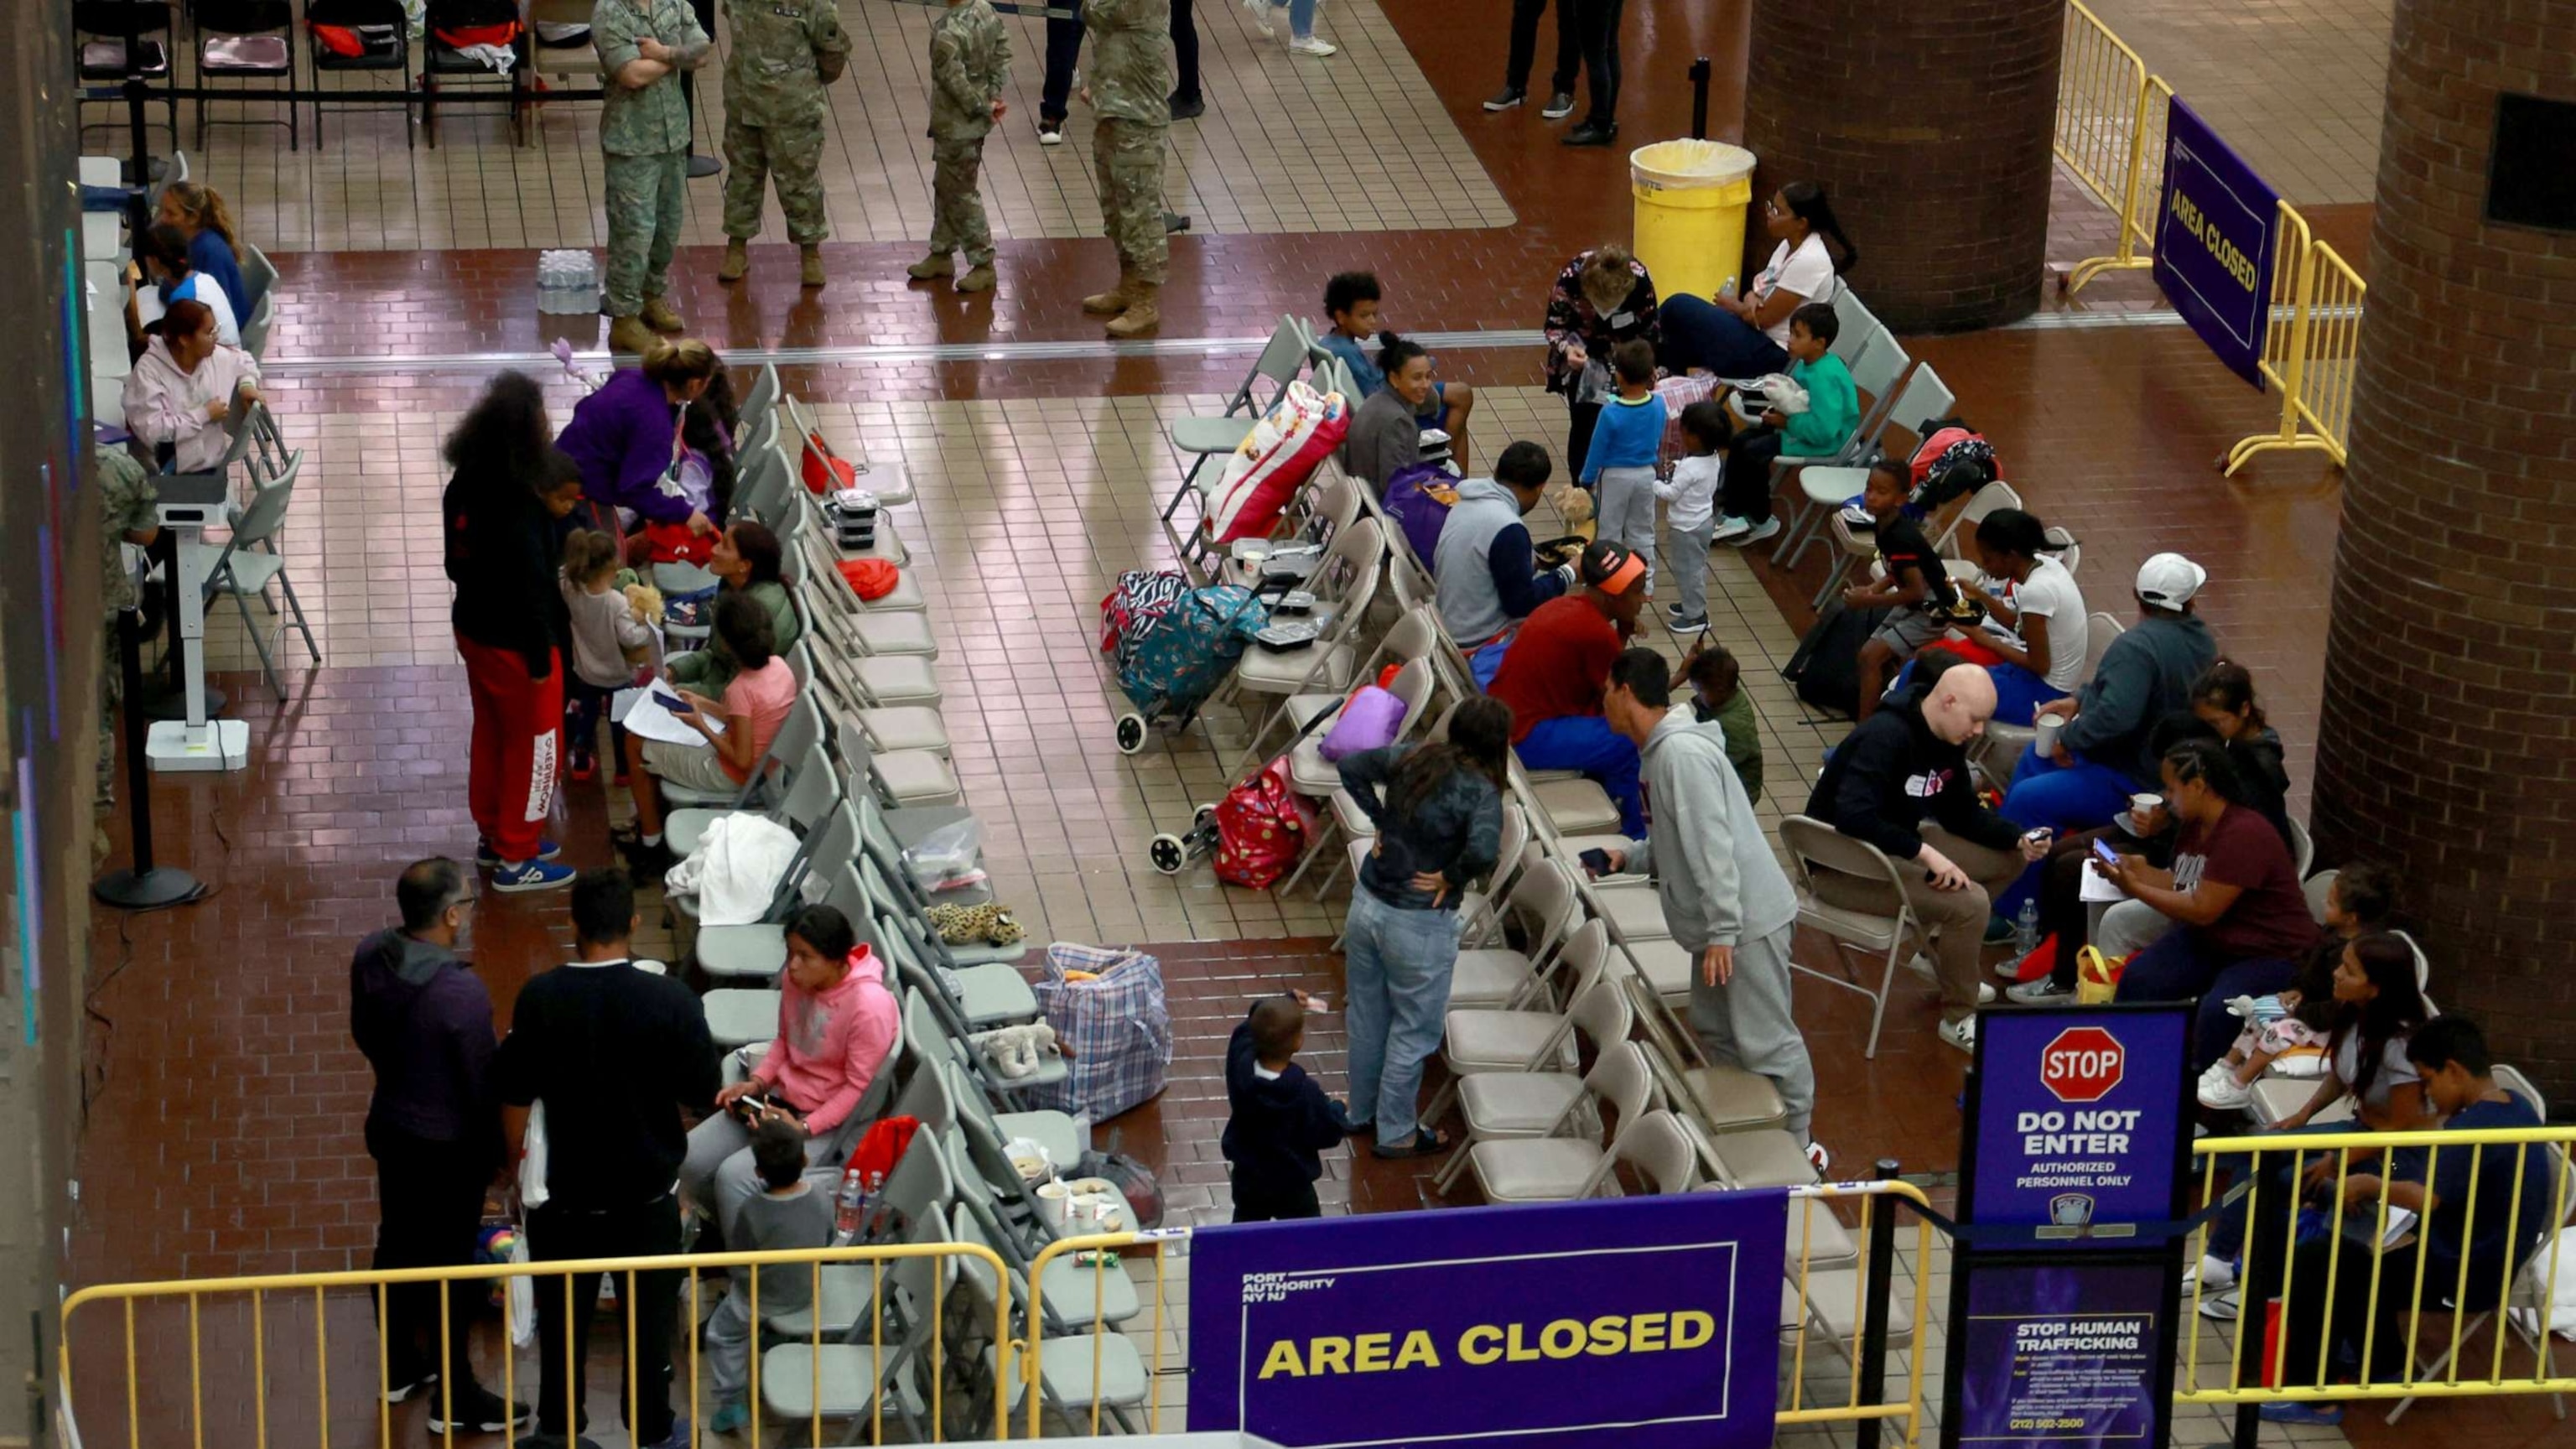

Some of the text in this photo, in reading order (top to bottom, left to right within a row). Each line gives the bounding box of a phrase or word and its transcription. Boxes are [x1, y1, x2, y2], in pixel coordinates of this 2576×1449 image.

[2172, 189, 2256, 292] AREA CLOSED
[2047, 1050, 2118, 1079] STOP
[2018, 1110, 2141, 1132] DO NOT
[2024, 1134, 2129, 1155] ENTER
[2030, 1162, 2116, 1174] AUTHORIZED
[2016, 1176, 2131, 1187] PERSONNEL ONLY
[1242, 1278, 1336, 1292] AUTHORITY
[1243, 1272, 1286, 1284] PORT
[1242, 1291, 1286, 1303] NY NJ
[2017, 1321, 2141, 1337] STOP HUMAN
[1258, 1310, 1716, 1379] AREA CLOSED
[2016, 1337, 2138, 1352] TRAFFICKING
